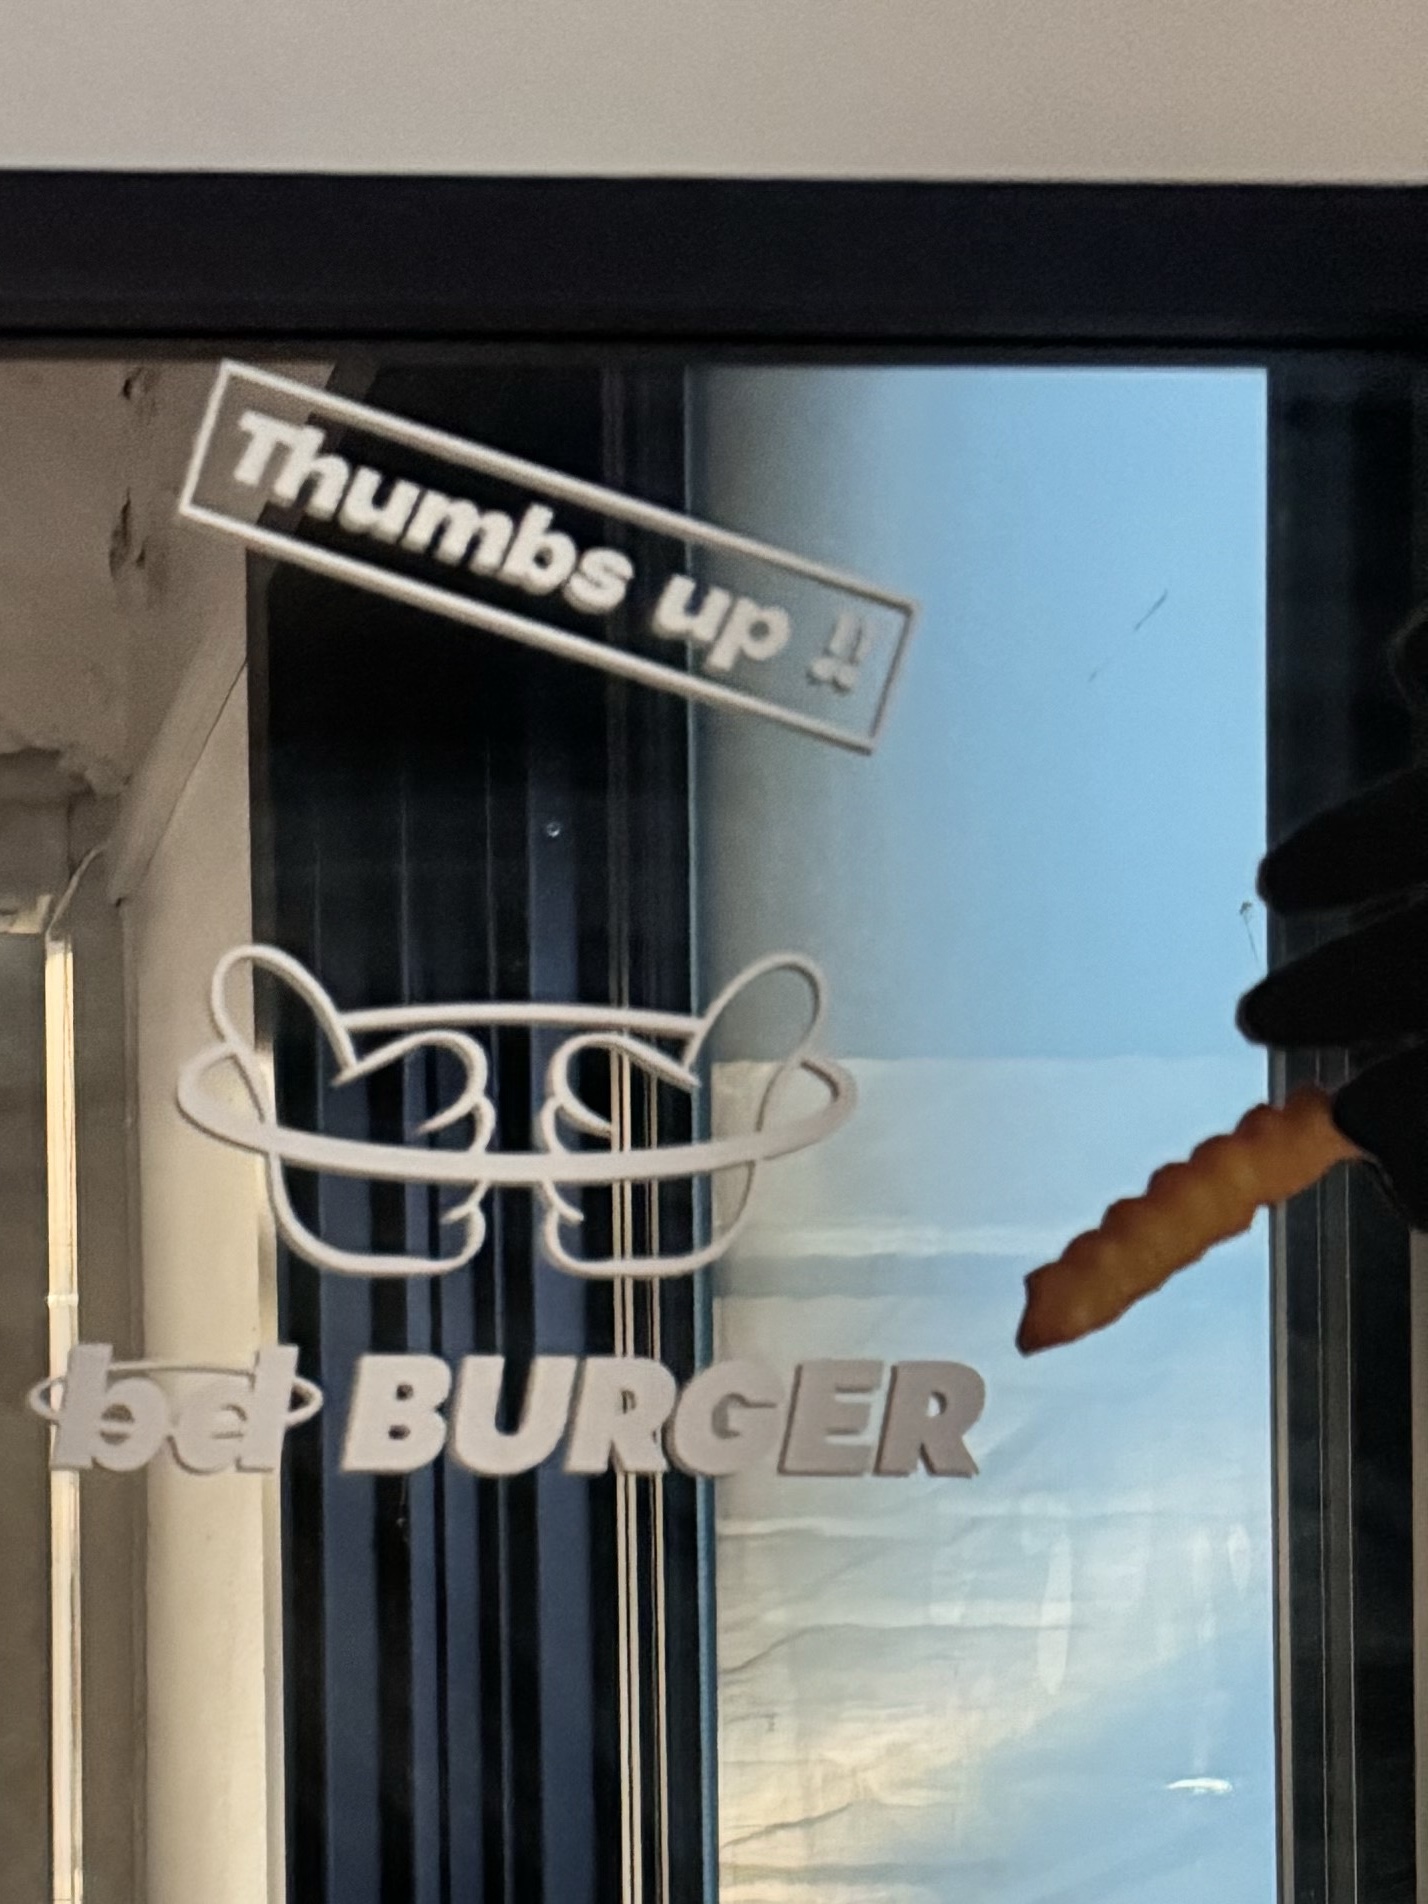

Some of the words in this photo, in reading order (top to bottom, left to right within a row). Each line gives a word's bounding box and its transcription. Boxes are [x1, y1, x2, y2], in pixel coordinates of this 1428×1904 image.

[233, 409, 635, 615] Thumbs
[653, 570, 794, 673] up
[49, 1343, 300, 1475] bd
[342, 1353, 987, 1480] BURGER
